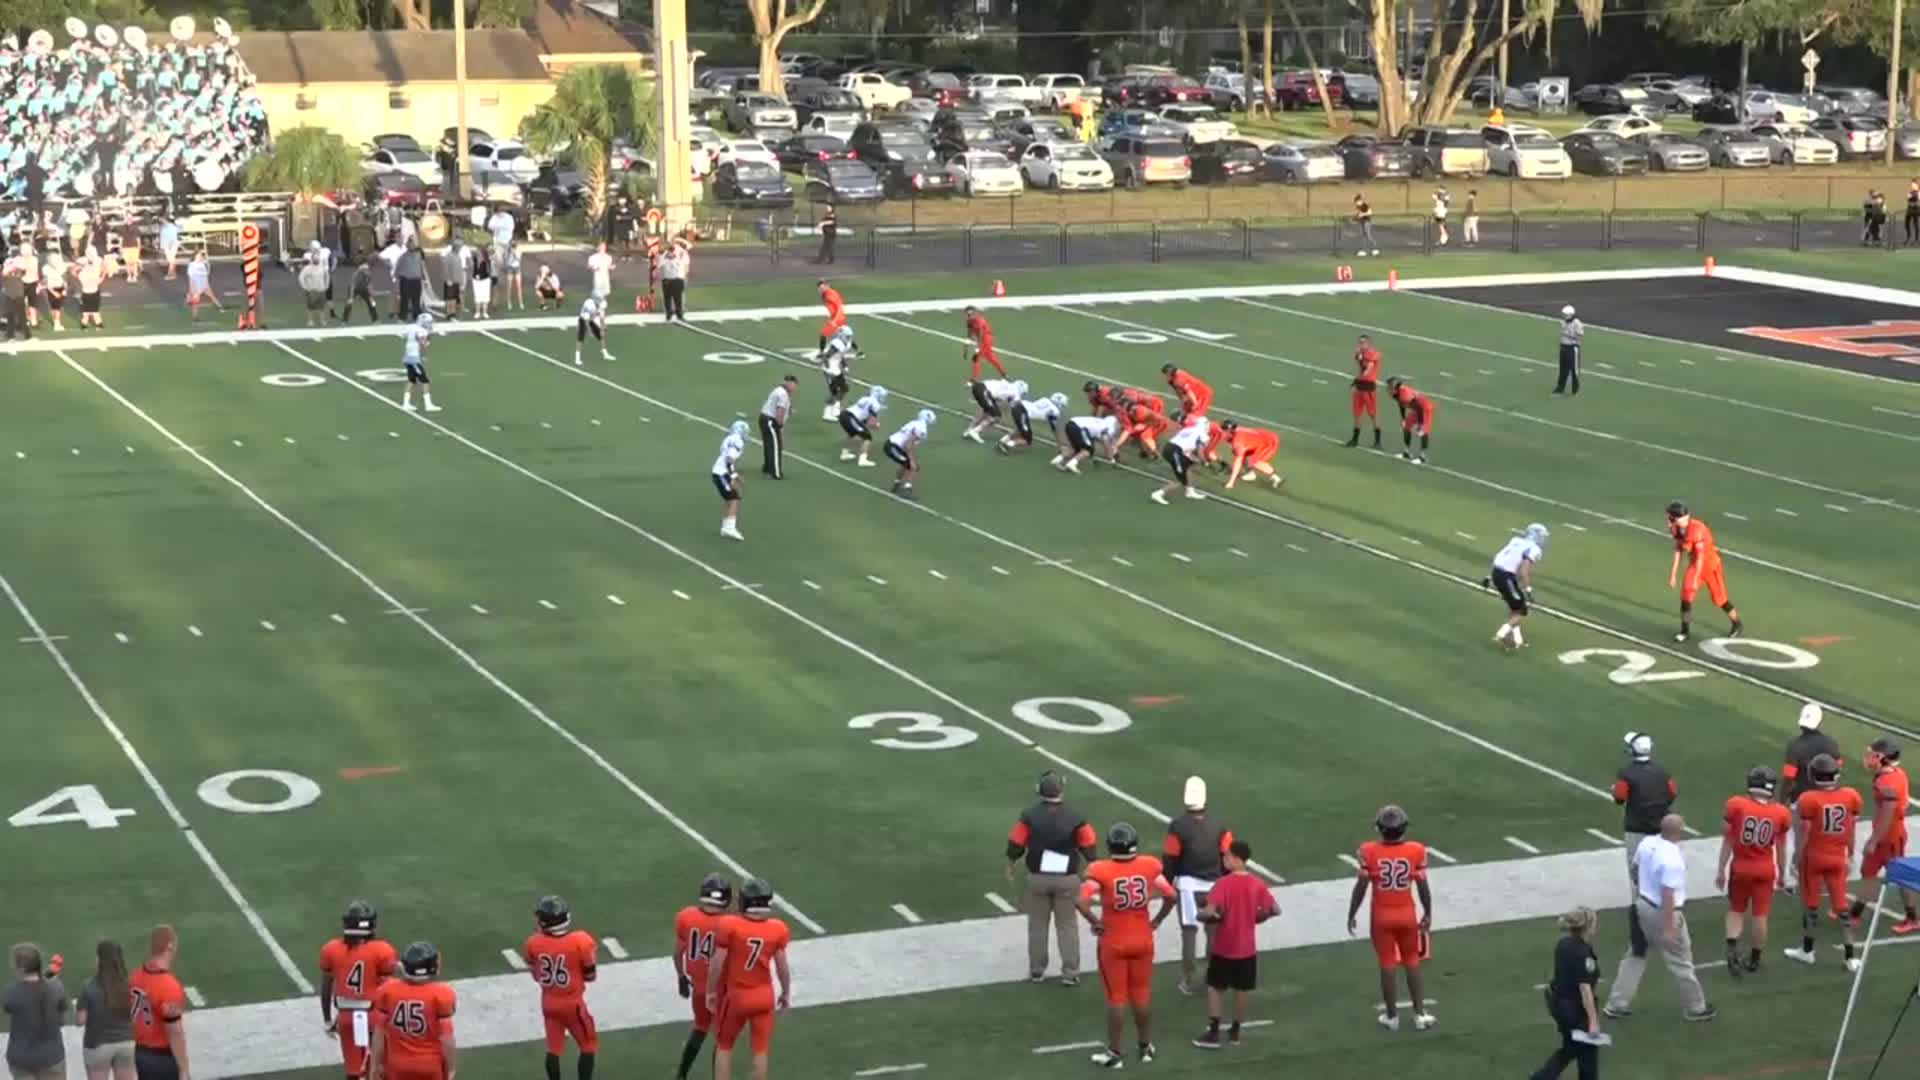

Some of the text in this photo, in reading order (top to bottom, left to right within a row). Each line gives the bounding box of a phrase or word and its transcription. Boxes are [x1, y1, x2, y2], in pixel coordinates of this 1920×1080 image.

[1557, 636, 1820, 684] 20
[848, 696, 1133, 750] 30
[7, 768, 322, 829] 40
[1740, 815, 1774, 848] 80
[1824, 803, 1847, 834] 12
[1377, 857, 1411, 890] 32
[1114, 875, 1149, 911] 53
[688, 927, 716, 961] 14
[744, 937, 764, 971] 7
[345, 959, 365, 995] 4
[538, 953, 570, 988] 36
[391, 1000, 427, 1037] 45
